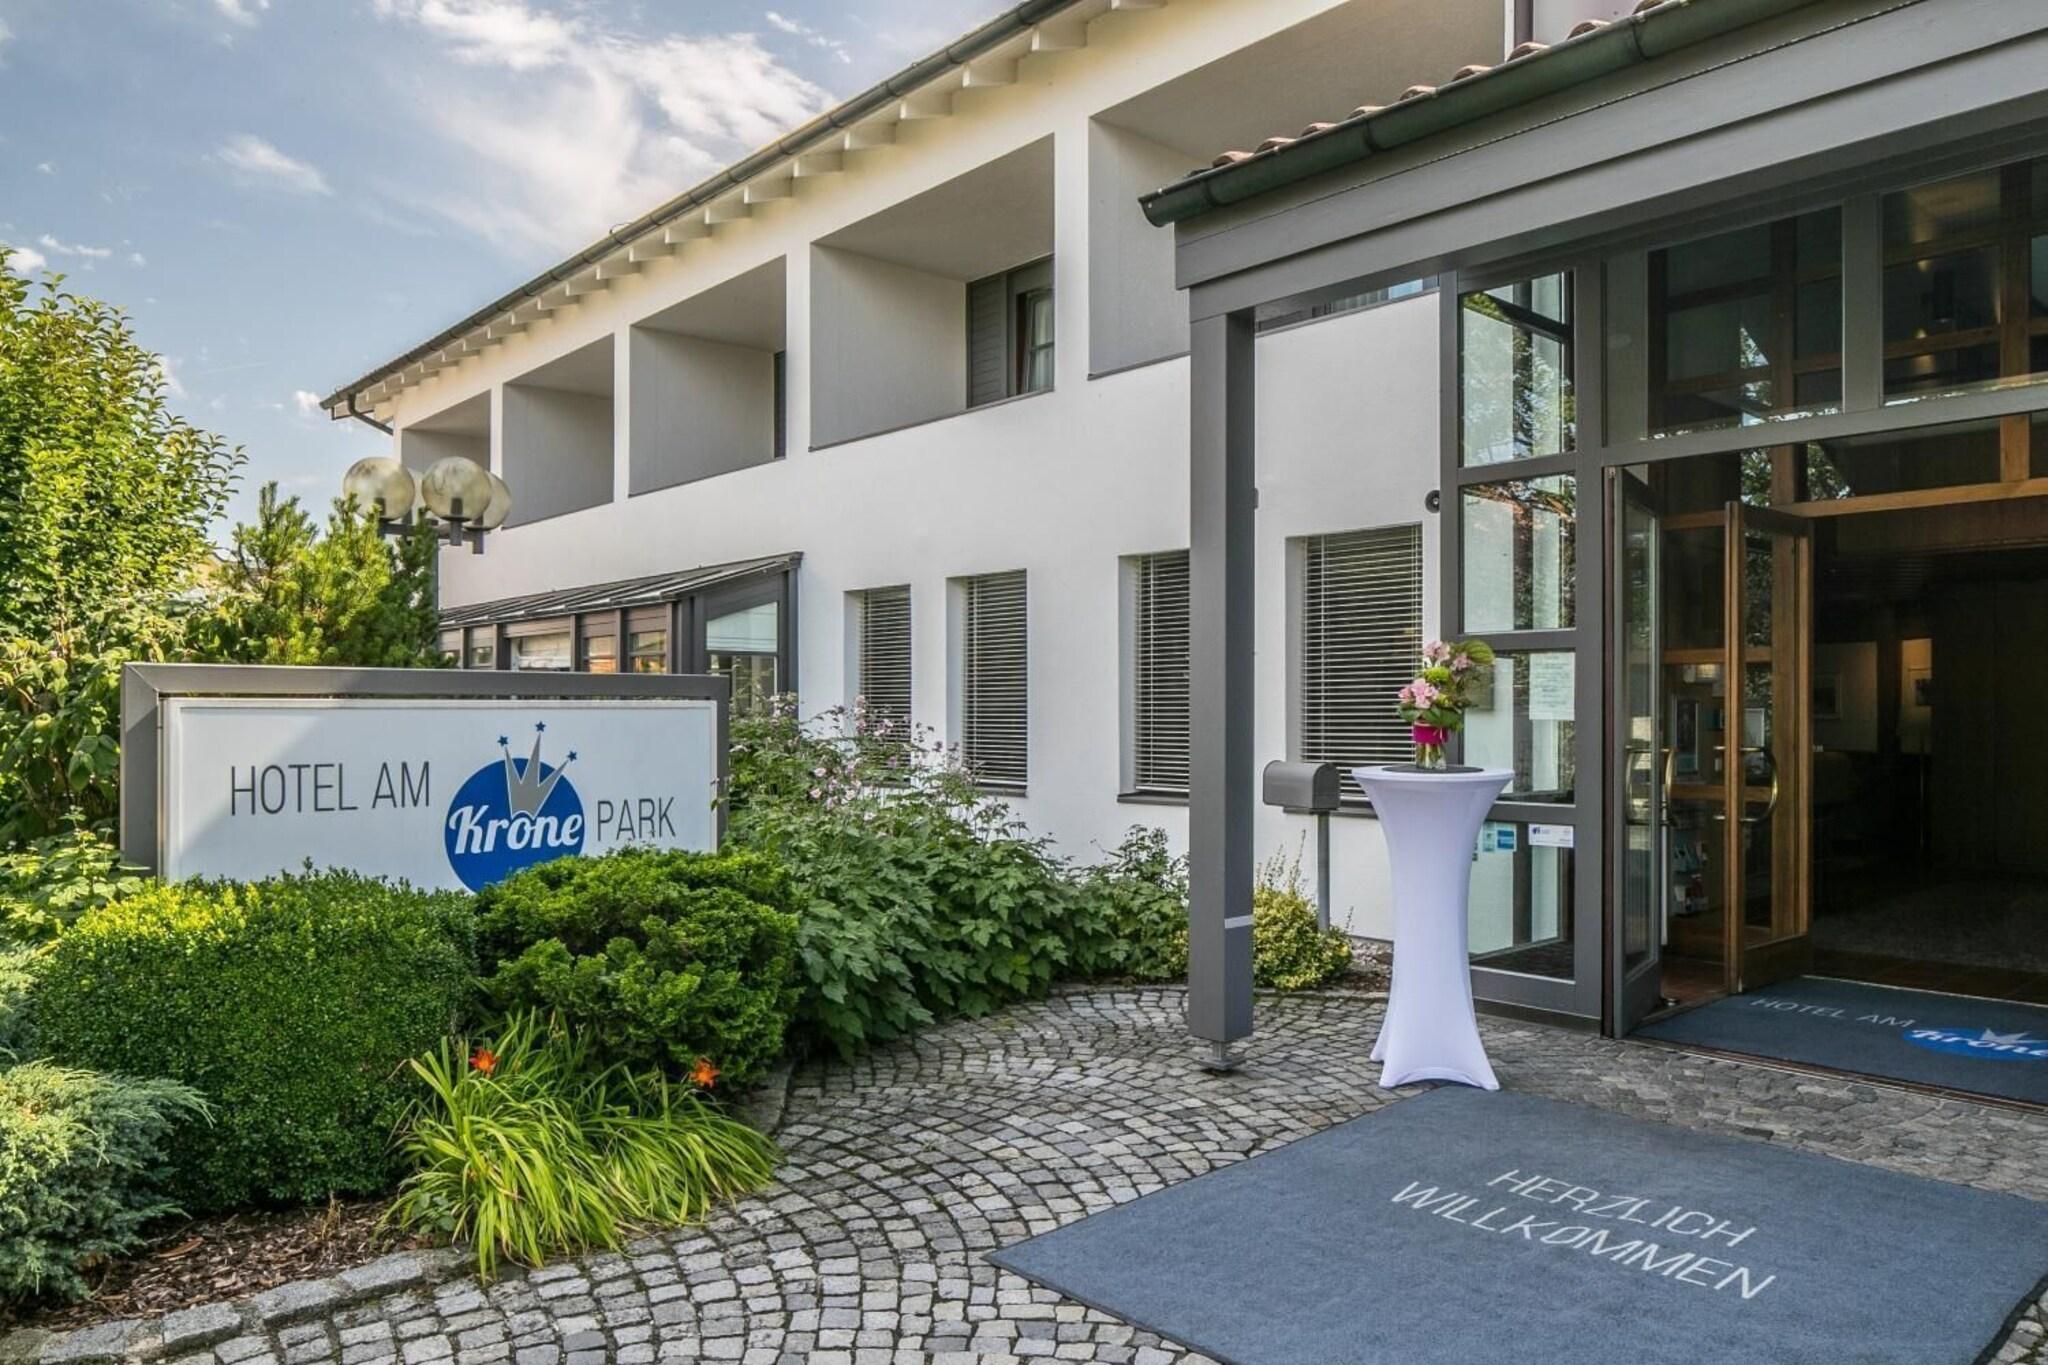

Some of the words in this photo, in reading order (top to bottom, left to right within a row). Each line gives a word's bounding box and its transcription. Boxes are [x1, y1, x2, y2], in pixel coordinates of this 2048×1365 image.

[230, 762, 358, 816] HOTEL
[371, 761, 431, 809] AM
[448, 804, 583, 855] Krone
[597, 797, 676, 842] PARK
[1750, 998, 1847, 1019] HOTEL
[1856, 1012, 1917, 1028] AM
[1391, 1181, 1776, 1299] WILLKOMMEN
[1487, 1169, 1757, 1247] HERZLICH
